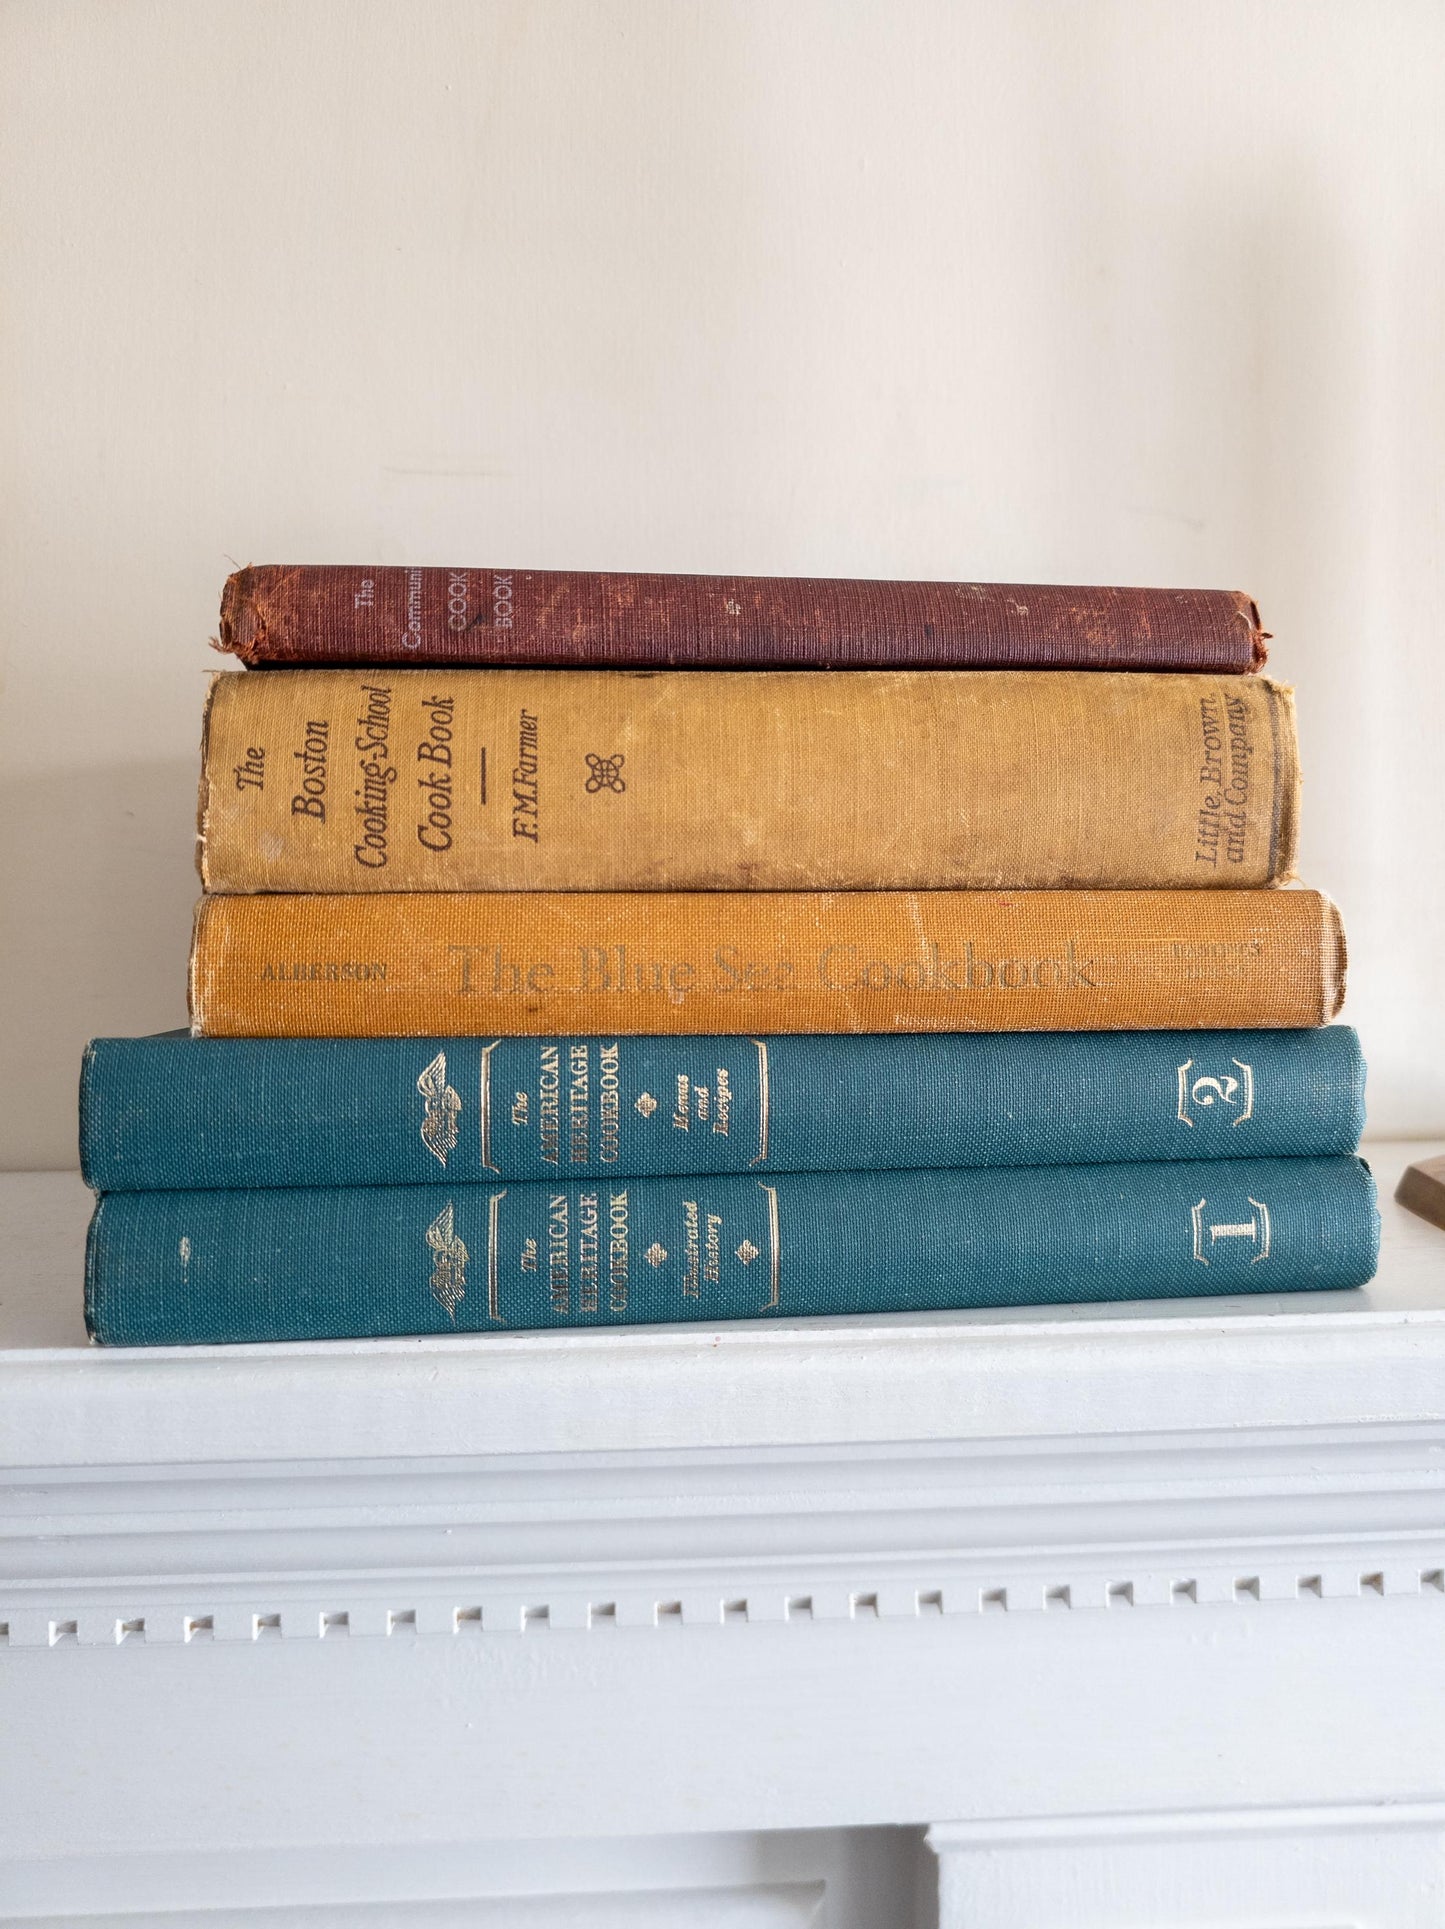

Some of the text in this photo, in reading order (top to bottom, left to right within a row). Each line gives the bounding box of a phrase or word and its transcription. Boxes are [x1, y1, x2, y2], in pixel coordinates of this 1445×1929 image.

[355, 578, 375, 609] The
[401, 566, 422, 650] Communi
[448, 571, 467, 632] COOK
[493, 574, 513, 630] BOOK
[236, 746, 266, 792] The
[291, 718, 330, 825] Boston
[354, 683, 398, 870] Cooking-School
[417, 694, 456, 853] Cook Book
[1223, 692, 1253, 864] and Company
[261, 960, 387, 981] ALBERSON
[448, 943, 556, 994] The
[576, 942, 697, 994] Blue
[817, 939, 1099, 993] Cookbook
[511, 1090, 528, 1126] The
[540, 1044, 559, 1166] AMERICAN
[570, 1044, 589, 1164] HERITAGE
[600, 1041, 620, 1164] COOKBOOK
[672, 1072, 690, 1133] Menus
[696, 1084, 710, 1121] and
[712, 1067, 734, 1137] Recipes
[519, 1237, 538, 1274] The
[549, 1194, 570, 1315] AMERICAN
[579, 1191, 599, 1314] HERITAGE
[609, 1188, 630, 1313] COOKBOOK
[682, 1200, 700, 1299] Illustrated
[703, 1212, 723, 1284] History
